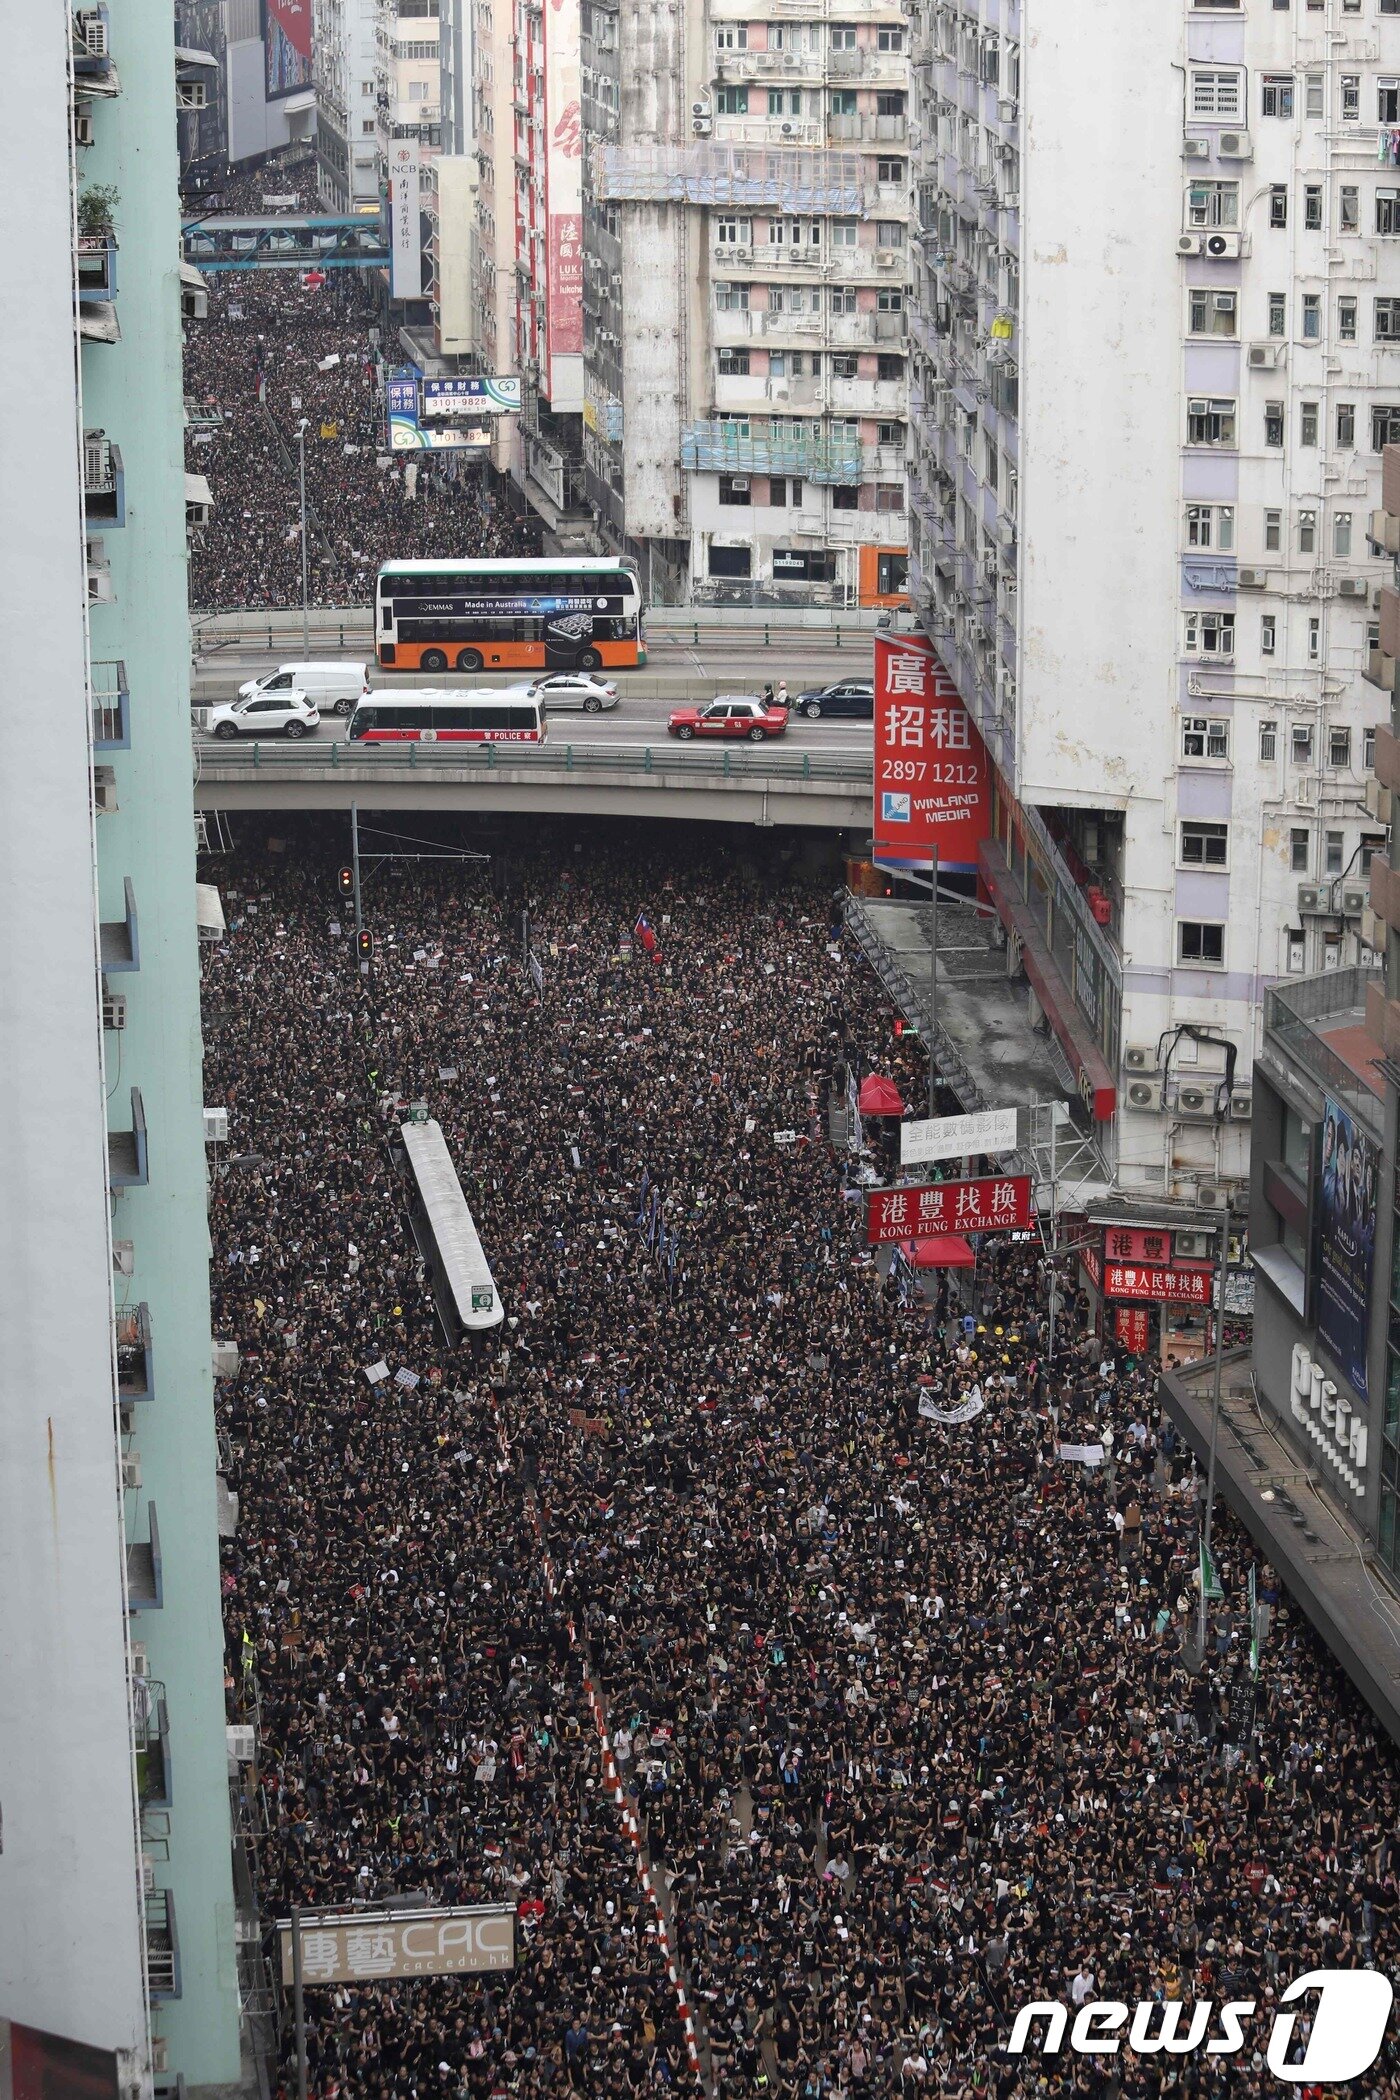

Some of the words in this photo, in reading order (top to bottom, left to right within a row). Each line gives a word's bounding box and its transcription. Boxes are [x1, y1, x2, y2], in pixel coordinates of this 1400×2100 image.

[392, 165, 417, 173] NCB
[400, 179, 411, 248] 南洋商業銀行
[561, 221, 578, 241] 陸
[560, 265, 577, 274] LUK
[390, 387, 413, 398] 保得
[431, 381, 480, 392] 保得財務
[391, 399, 414, 410] 財務
[432, 398, 487, 407] 3101-9828
[885, 653, 961, 696] 廣告
[484, 732, 491, 740] 警
[494, 732, 521, 740] POLICE
[524, 732, 531, 740] 察
[884, 704, 971, 750] 招租
[882, 759, 927, 781] 2897
[933, 763, 978, 785] 1212
[913, 793, 979, 810] WINLAND
[925, 808, 971, 823] MEDIA
[908, 1114, 1010, 1143] 全能數碼影像
[880, 1182, 1018, 1224] 港豐找換
[879, 1225, 912, 1239] KONG
[918, 1221, 949, 1234] FUNG
[954, 1212, 1017, 1230] EXCHANGE
[1112, 1233, 1165, 1259] 港豐
[1110, 1269, 1205, 1294] 港豐人民幣找換
[1110, 1287, 1130, 1295] KONG
[1131, 1288, 1149, 1296] FUNG
[1168, 1292, 1204, 1300] EXCHANGE
[402, 1917, 508, 1958] CAC
[403, 1953, 509, 1971] cac.edu.hk
